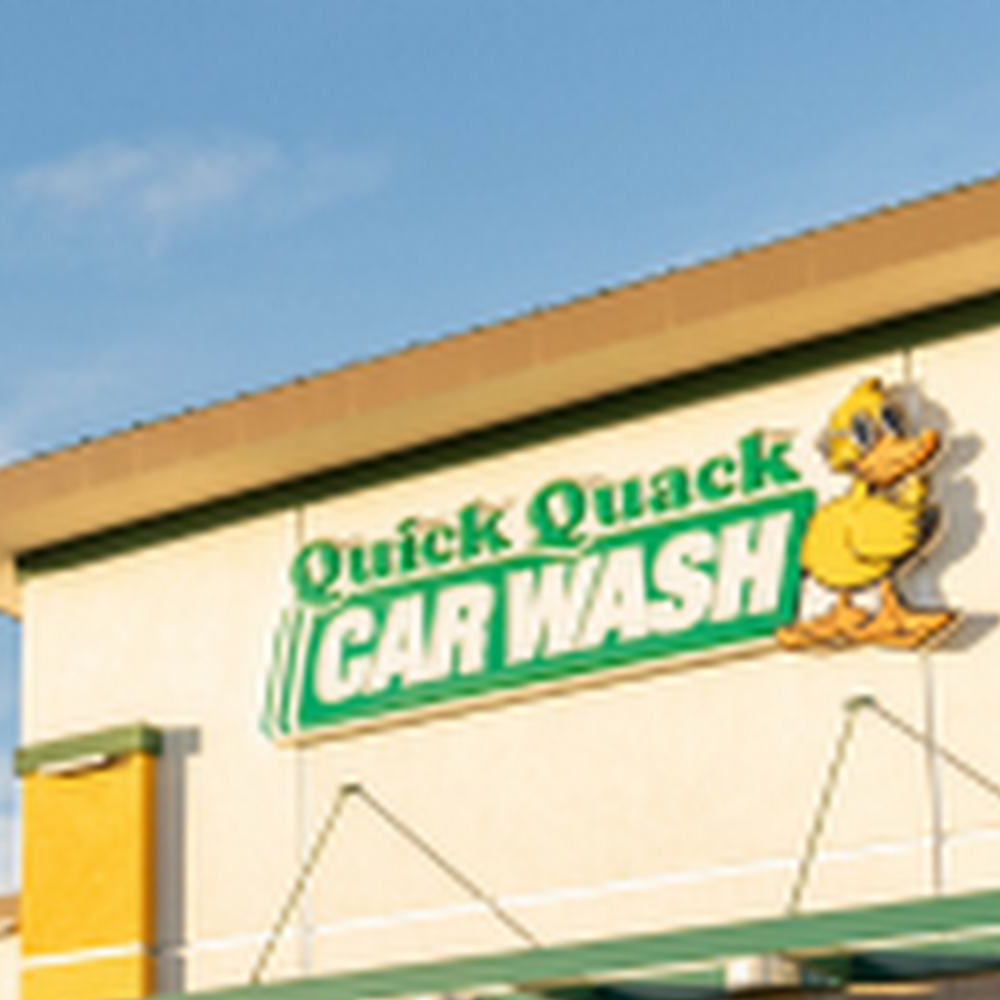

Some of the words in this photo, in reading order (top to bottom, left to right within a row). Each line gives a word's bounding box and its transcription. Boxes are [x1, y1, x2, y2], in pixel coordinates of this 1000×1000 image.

[290, 503, 513, 600] Quick
[526, 430, 800, 548] Quack
[313, 580, 496, 705] CAR
[502, 510, 796, 665] WASH
